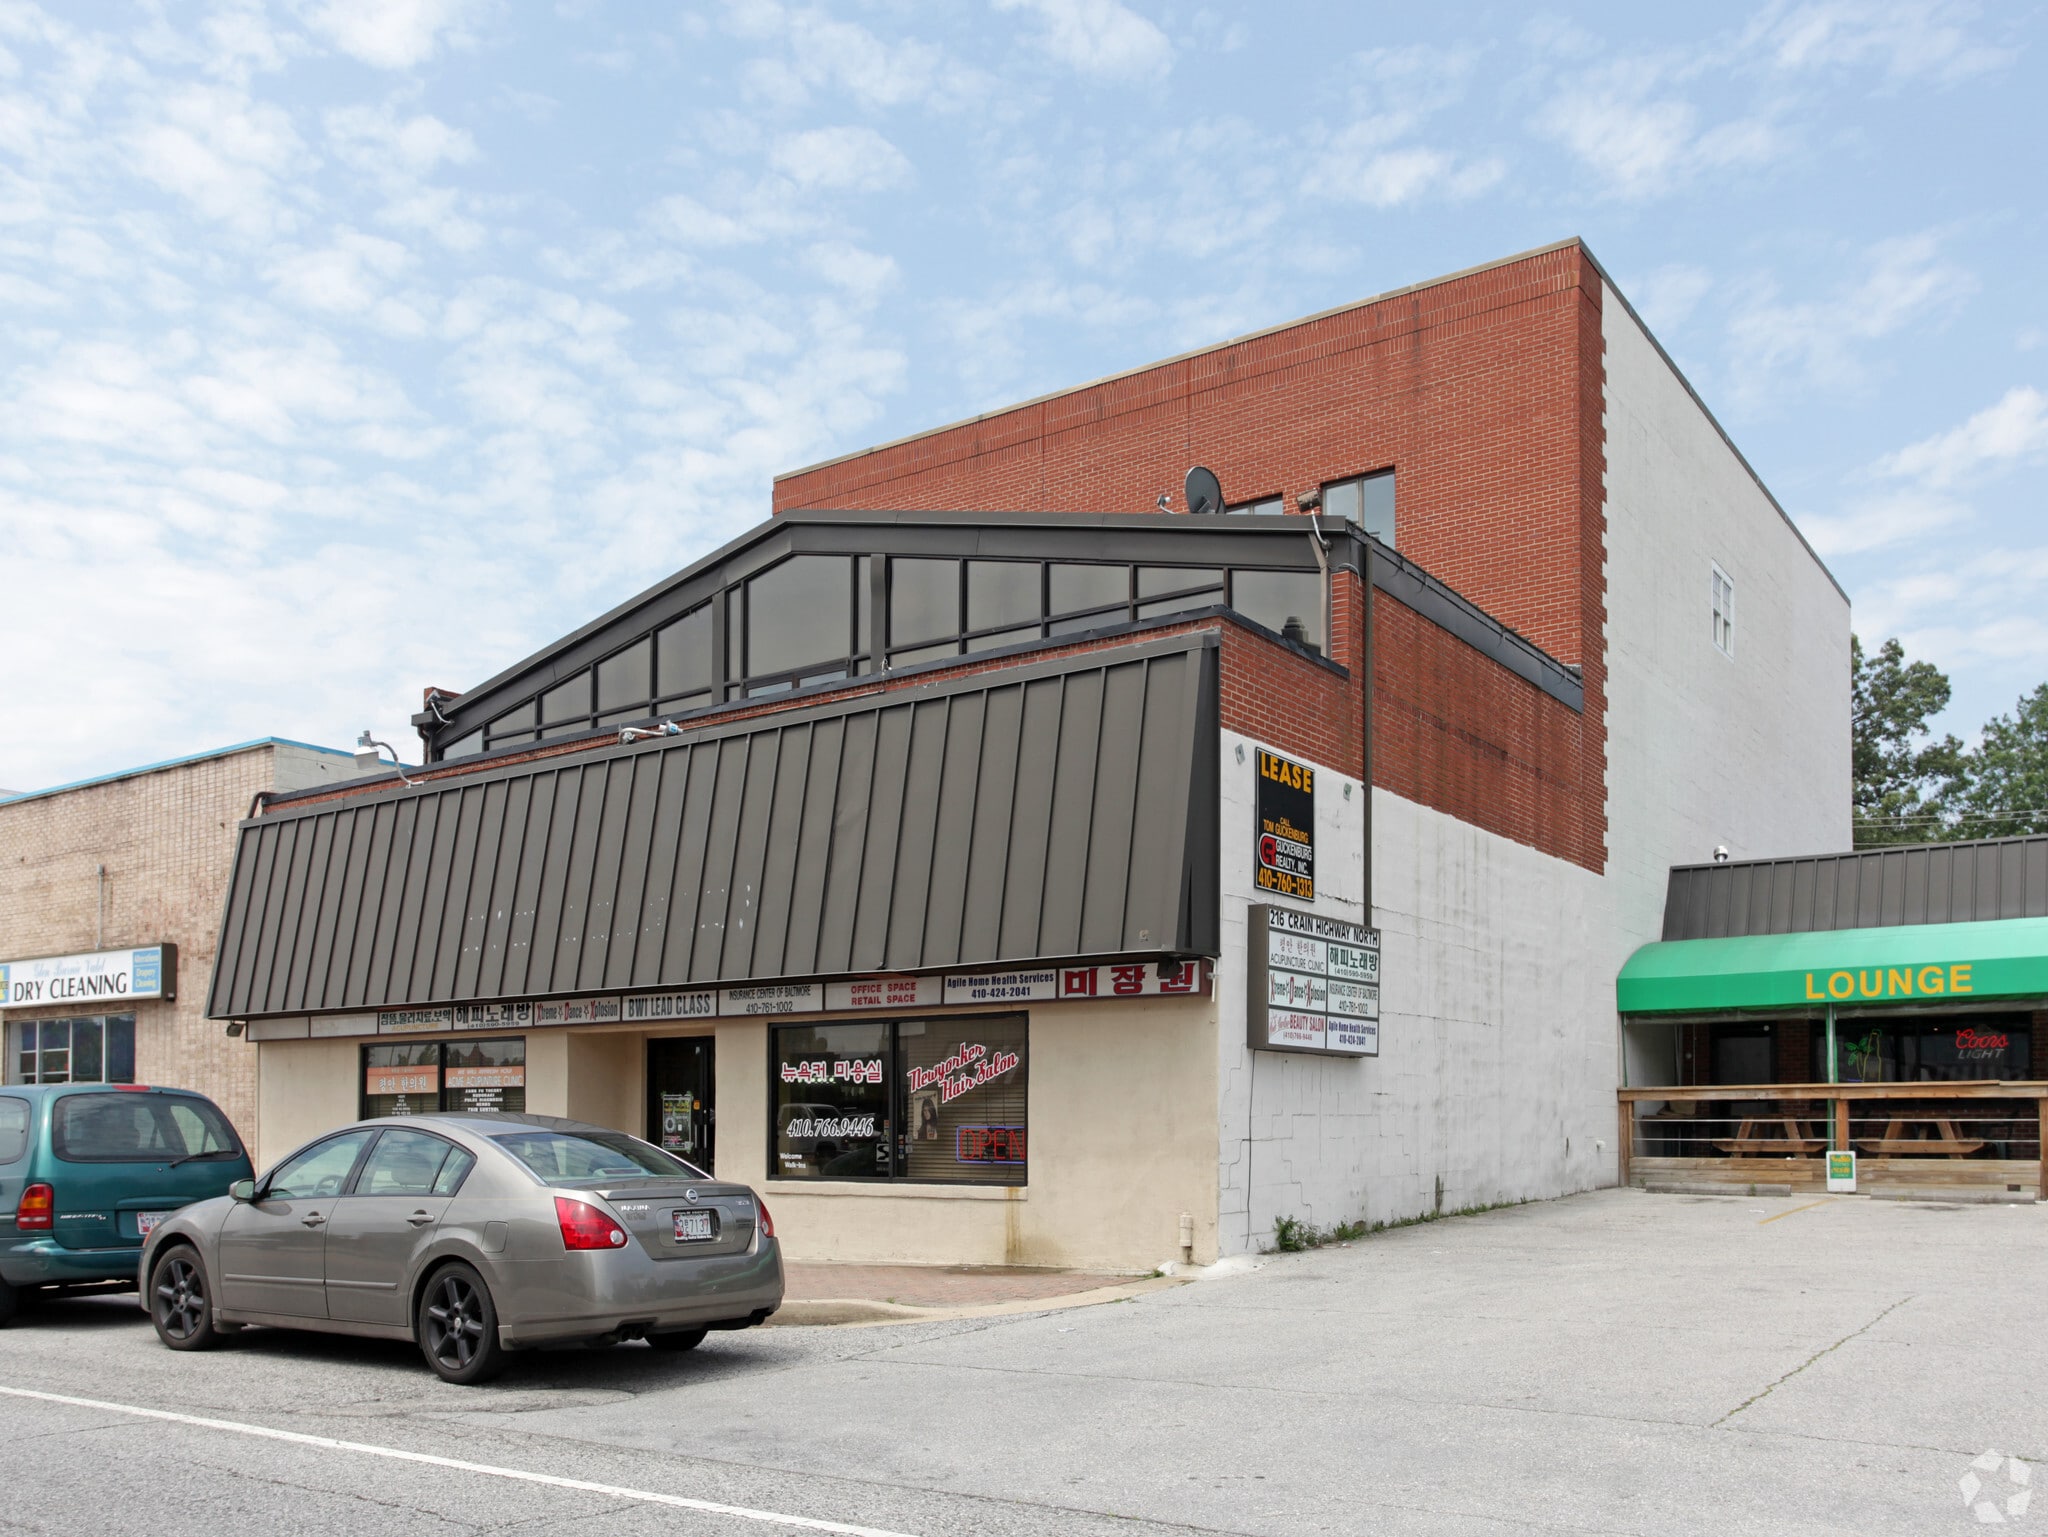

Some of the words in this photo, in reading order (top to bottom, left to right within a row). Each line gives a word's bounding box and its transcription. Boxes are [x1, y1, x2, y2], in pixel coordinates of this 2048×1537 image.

[1261, 751, 1311, 793] LEASE
[1264, 819, 1274, 832] TOM
[1259, 867, 1312, 898] 410-760-1313
[1270, 909, 1284, 926] 216
[1288, 913, 1313, 932] CRAIN
[1316, 919, 1350, 940] HIGHWAY
[1353, 928, 1378, 946] NORTH
[1307, 960, 1325, 972] CLINIC
[1329, 947, 1377, 972] 해피노래방
[14, 980, 44, 1001] DRY
[50, 972, 127, 999] CLEANING
[851, 984, 882, 994] OFFICE
[887, 982, 917, 992] SPACE
[947, 976, 967, 988] Agile
[968, 975, 990, 987] Home
[991, 973, 1017, 985] Health
[1018, 972, 1054, 984] Services
[1805, 964, 1973, 1000] LOUNGE
[729, 987, 755, 1000] INSURANCE
[756, 986, 776, 999] CENTER
[777, 986, 784, 998] OF
[784, 985, 812, 997] BALTIMORE
[851, 995, 882, 1005] RETAIL
[886, 994, 916, 1004] SPACE
[971, 987, 1031, 999] 410-424-2041
[455, 1003, 531, 1024] 해피노래방
[536, 1004, 558, 1023] Xtreme
[564, 1002, 582, 1021] Dance
[590, 1000, 618, 1021] Xplosion
[628, 998, 648, 1018] BWI
[651, 996, 673, 1016] LEAD
[676, 993, 710, 1015] CLASS
[745, 1001, 793, 1013] 410-761-1002
[1290, 1014, 1309, 1031] BEAUTY
[1310, 1016, 1324, 1032] SALON
[1955, 1028, 2009, 1049] Coors
[1958, 1048, 2005, 1059] LIGHT
[781, 1060, 827, 1084] 뉴욕커
[834, 1060, 882, 1084] 미용실
[907, 1042, 987, 1093] Newyorker
[938, 1073, 976, 1104] Hair
[975, 1052, 1019, 1084] Salon
[786, 1117, 875, 1138] 410.766.9446
[960, 1129, 1025, 1160] OPEN
